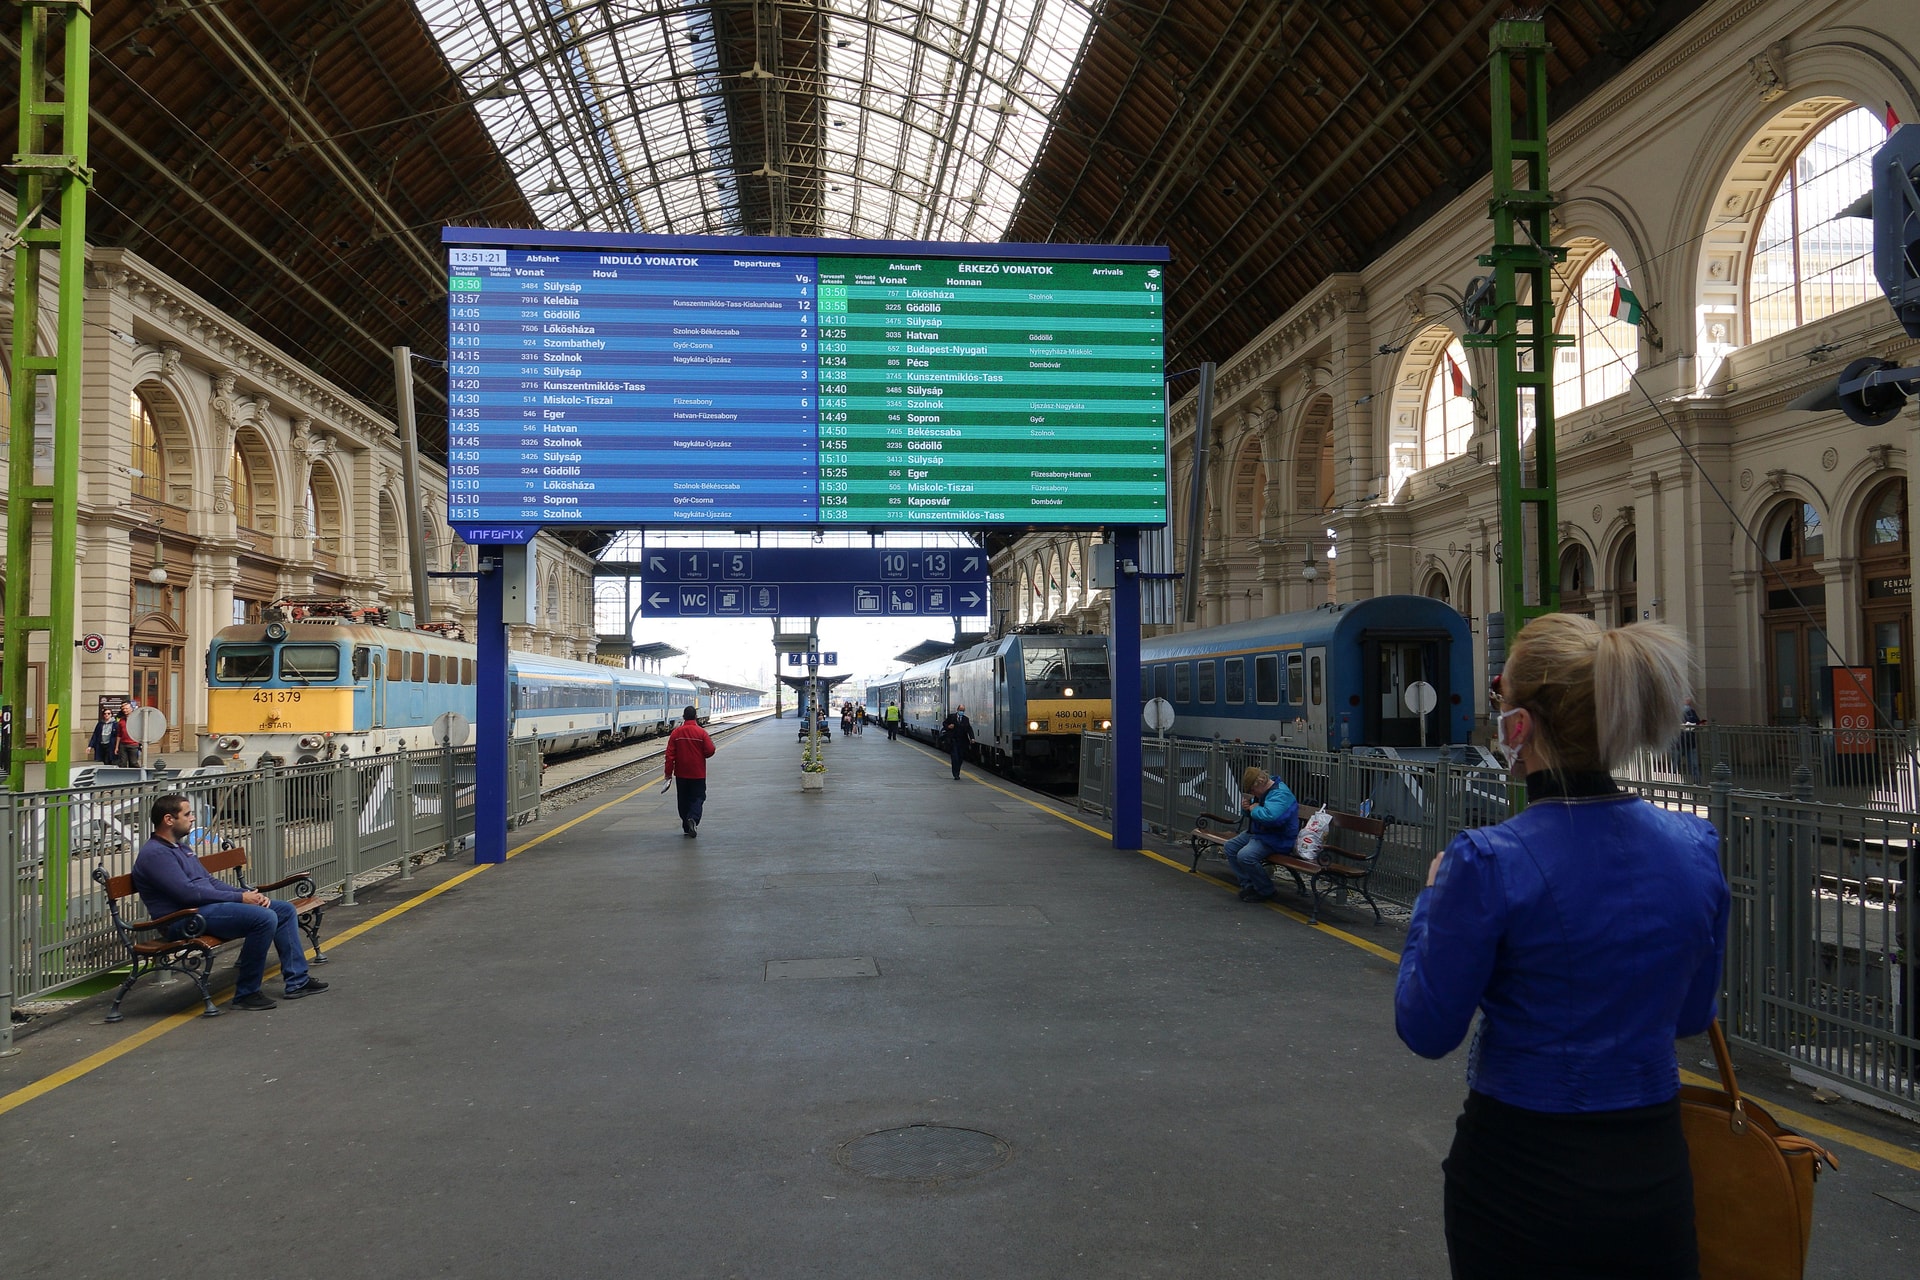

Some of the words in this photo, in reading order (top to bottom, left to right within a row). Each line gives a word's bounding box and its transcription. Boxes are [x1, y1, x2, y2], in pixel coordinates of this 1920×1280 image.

[455, 253, 500, 262] 13:51:21
[600, 255, 642, 266] INDULÓ
[645, 257, 699, 266] VONATOK
[734, 260, 781, 268] Departures
[959, 263, 1000, 273] ÉRKEZŐ
[1002, 266, 1053, 274] VONATOK
[515, 268, 545, 276] Vonat
[593, 270, 618, 278] Hová
[795, 274, 812, 284] Vg.
[451, 280, 479, 289] 13:50
[543, 282, 581, 293] Sülysáp
[801, 287, 808, 296] 4
[947, 278, 982, 286] Honnan
[1145, 282, 1159, 291] Vg.
[820, 287, 846, 297] 13:50
[906, 289, 955, 299] Lőkösháza
[451, 294, 479, 303] 13:57
[543, 296, 579, 305] Kelebia
[798, 301, 810, 310] 12
[820, 301, 846, 310] 13:55
[906, 303, 941, 312] Gödöllő
[451, 308, 479, 317] 14:05
[543, 310, 580, 319] Gödöllő
[801, 315, 808, 324] 4
[820, 315, 847, 324] 14:10
[906, 317, 942, 328] Sülysáp
[451, 323, 479, 332] 14:10
[543, 324, 595, 334] Lőkösháza
[801, 329, 808, 337] 2
[820, 329, 847, 338] 14:25
[907, 331, 939, 340] Hatvan
[451, 337, 479, 346] 14:10
[543, 339, 605, 350] Szombathely
[801, 343, 808, 351] 9
[820, 343, 847, 352] 14:30
[907, 345, 988, 357] Budapest-Nyugati
[451, 351, 479, 360] 14:15
[543, 353, 582, 362] Szolnok
[820, 357, 847, 366] 14:34
[907, 358, 929, 367] Pécs
[451, 366, 479, 375] 14:20
[543, 367, 581, 378] Sülysáp
[801, 371, 808, 379] 3
[820, 371, 847, 380] 14:38
[907, 372, 1003, 382] Kunszentmiklós-Tass
[451, 380, 479, 389] 14:20
[543, 381, 646, 391] Kunszentmiklós-Tass
[820, 385, 847, 394] 14:40
[907, 386, 943, 397] Sülysáp
[451, 394, 479, 403] 14:30
[543, 395, 613, 405] Miskolc-Tiszai
[801, 399, 808, 407] 6
[820, 399, 847, 408] 14:45
[907, 400, 943, 409] Szolnok
[451, 409, 479, 418] 14:35
[543, 410, 565, 421] Eger
[820, 413, 847, 422] 14:49
[907, 414, 940, 425] Sopron
[451, 423, 479, 432] 14:35
[543, 424, 577, 433] Hatvan
[820, 427, 847, 436] 14:50
[907, 428, 961, 437] Békéscsaba
[451, 437, 479, 446] 14:45
[543, 438, 582, 447] Szolnok
[821, 441, 847, 449] 14:55
[907, 441, 942, 450] Gödöllő
[451, 452, 479, 461] 14:50
[543, 452, 581, 463] Sülysáp
[821, 455, 848, 463] 15:10
[907, 455, 943, 466] Sülysáp
[451, 466, 479, 475] 15:05
[543, 467, 580, 476] Gödöllő
[821, 468, 848, 477] 15:25
[908, 469, 928, 480] Eger
[451, 480, 479, 489] 15:10
[543, 481, 595, 490] Lőkösháza
[821, 482, 848, 491] 15:30
[908, 483, 974, 492] Miskolc-Tiszai
[451, 495, 479, 504] 15:10
[543, 495, 578, 506] Sopron
[821, 496, 848, 505] 15:34
[908, 497, 950, 508] Kaposvár
[451, 509, 479, 518] 15:15
[543, 509, 582, 518] Szolnok
[821, 510, 848, 519] 15:38
[908, 511, 1005, 520] Kunszentmiklós-Tass
[689, 554, 697, 571] 1
[732, 555, 743, 572] 5
[884, 555, 904, 571] 10
[926, 555, 945, 571] 13
[682, 594, 707, 606] WC
[253, 692, 273, 702] 431
[278, 692, 300, 702] 379
